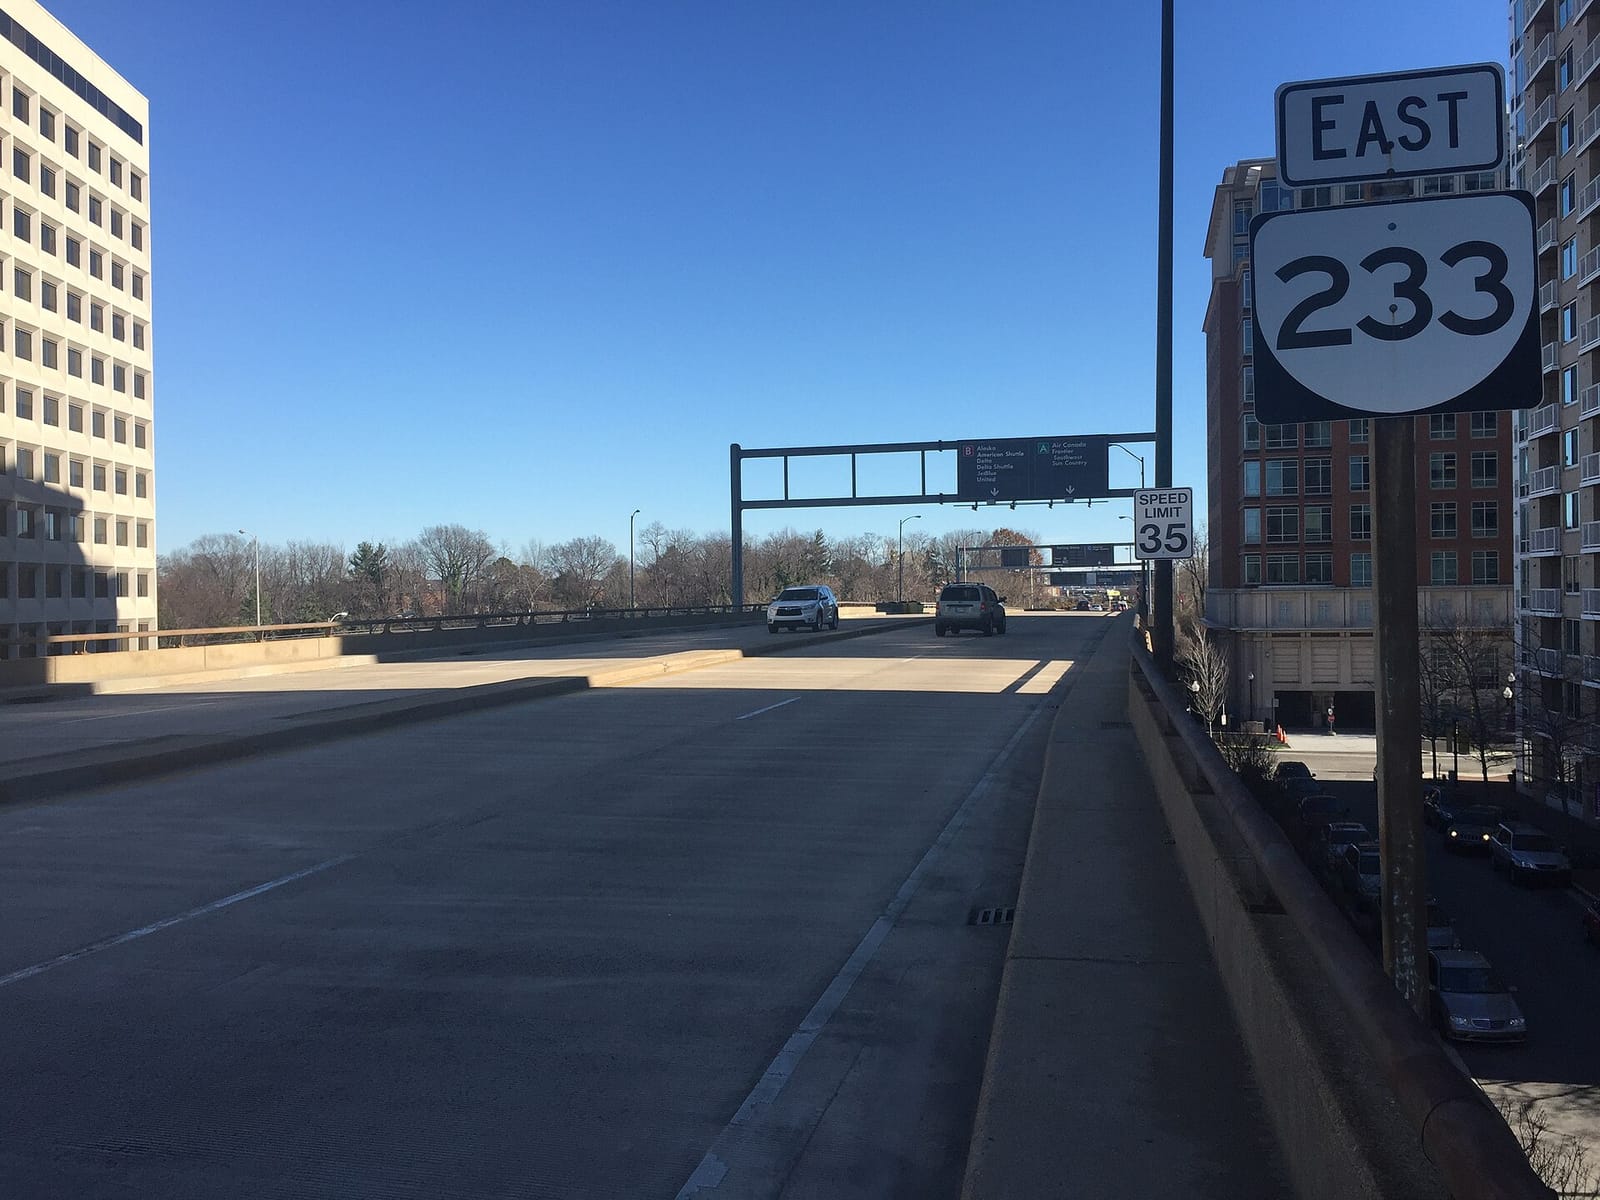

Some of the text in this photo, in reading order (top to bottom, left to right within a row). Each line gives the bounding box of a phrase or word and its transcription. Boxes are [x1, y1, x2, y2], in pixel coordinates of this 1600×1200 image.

[1311, 91, 1468, 161] EAST
[1274, 241, 1515, 350] 233
[1040, 444, 1047, 453] A
[1139, 493, 1188, 505] SPEED
[1145, 507, 1182, 518] LIMIT
[1139, 524, 1188, 553] 35
